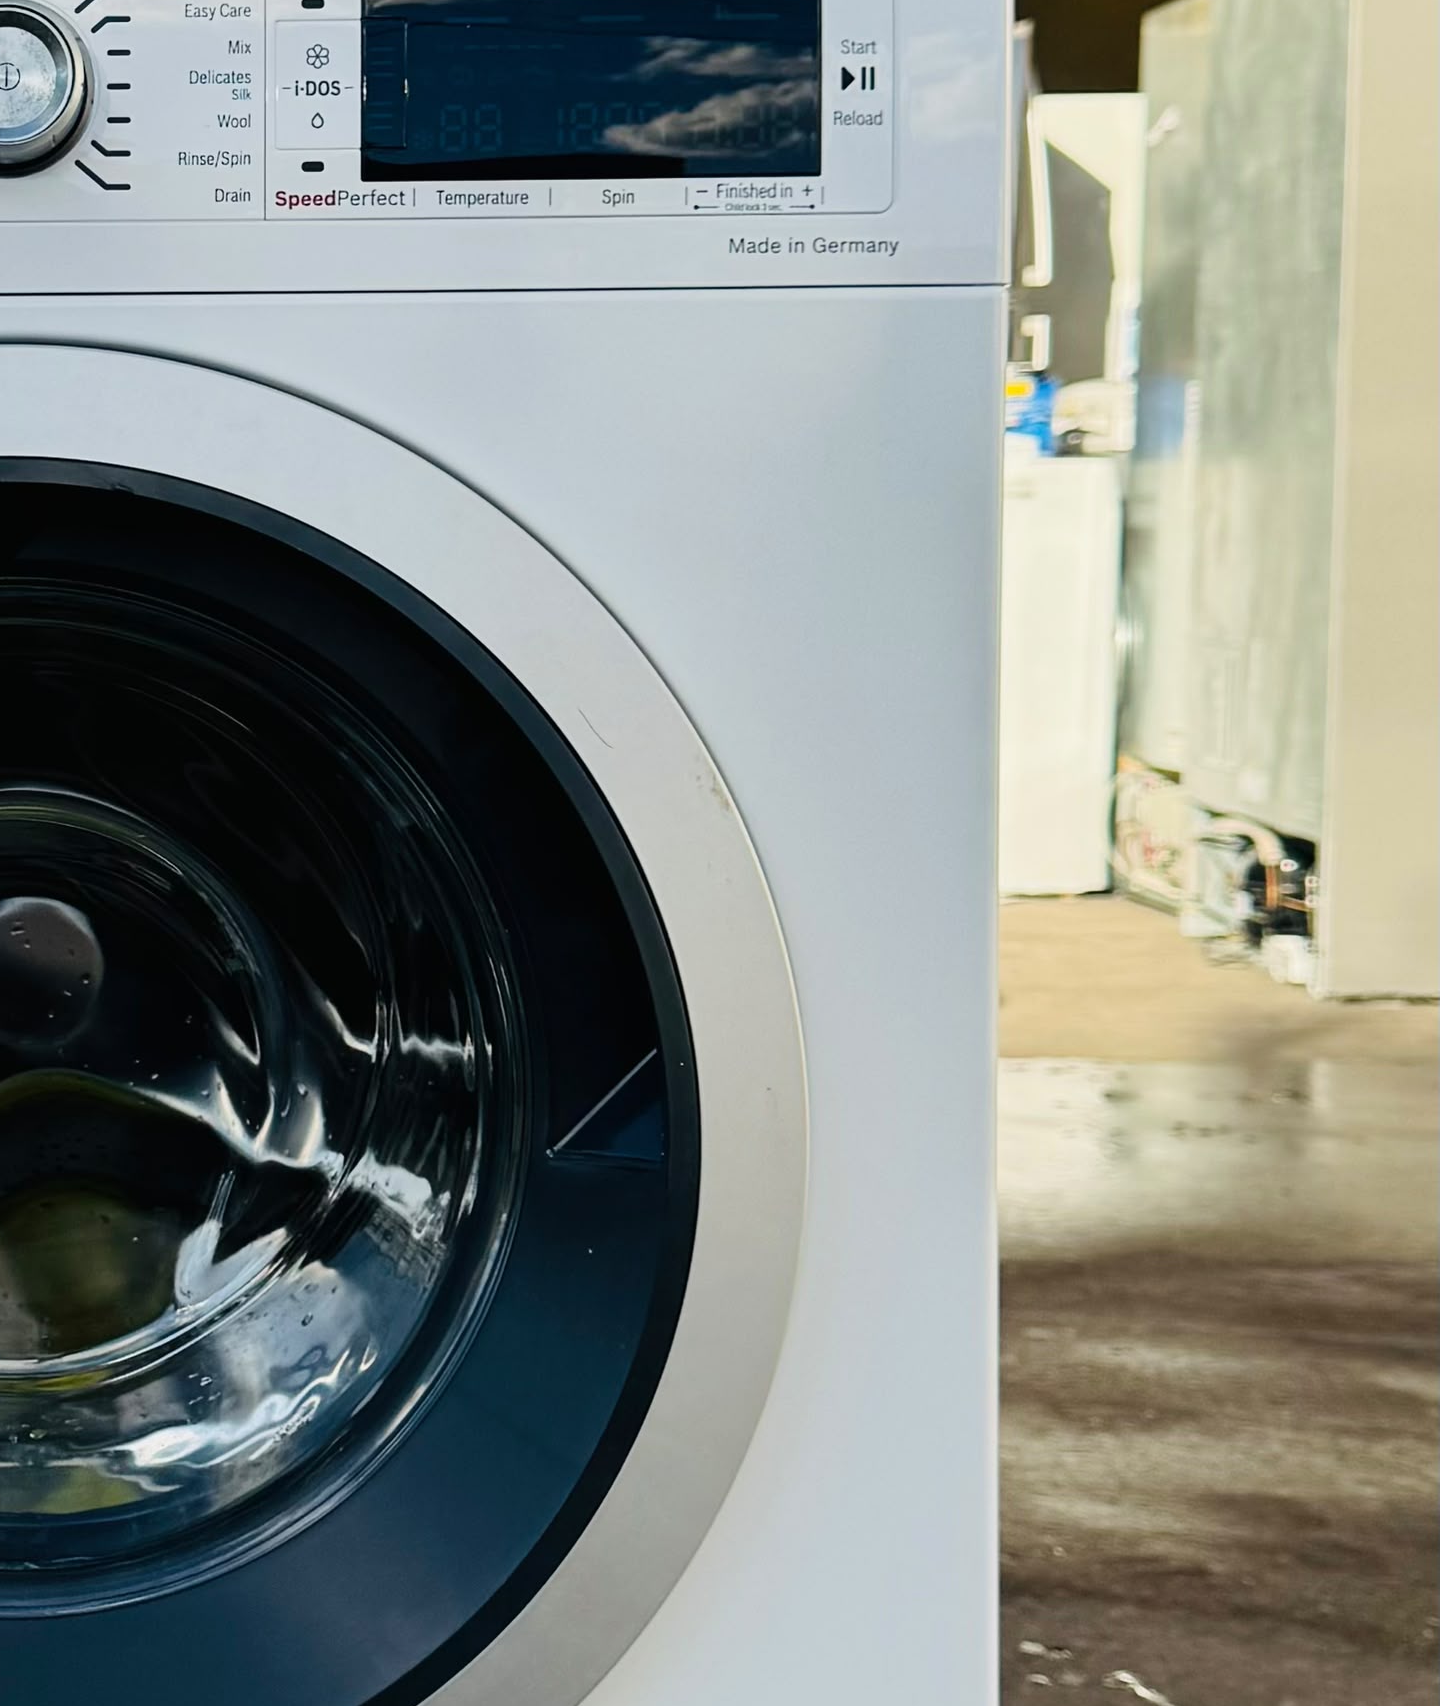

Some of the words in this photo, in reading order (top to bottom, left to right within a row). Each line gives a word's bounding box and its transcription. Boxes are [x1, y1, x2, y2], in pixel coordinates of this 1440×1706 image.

[184, 3, 216, 20] Easy
[218, 3, 251, 18] Care
[228, 40, 252, 55] Mix
[840, 40, 877, 55] Start
[189, 70, 251, 85] Delicates
[217, 114, 252, 129] Wool
[833, 111, 883, 127] Reload
[177, 151, 252, 168] Rinse/Spin
[214, 188, 251, 203] Drain
[275, 190, 405, 209] SpeedPerfect
[436, 190, 529, 208] Temperature
[602, 190, 635, 207] Spin
[716, 184, 777, 199] Finished
[780, 184, 792, 198] in
[728, 238, 781, 253] Made
[789, 237, 805, 253] in
[813, 237, 899, 256] Germany
